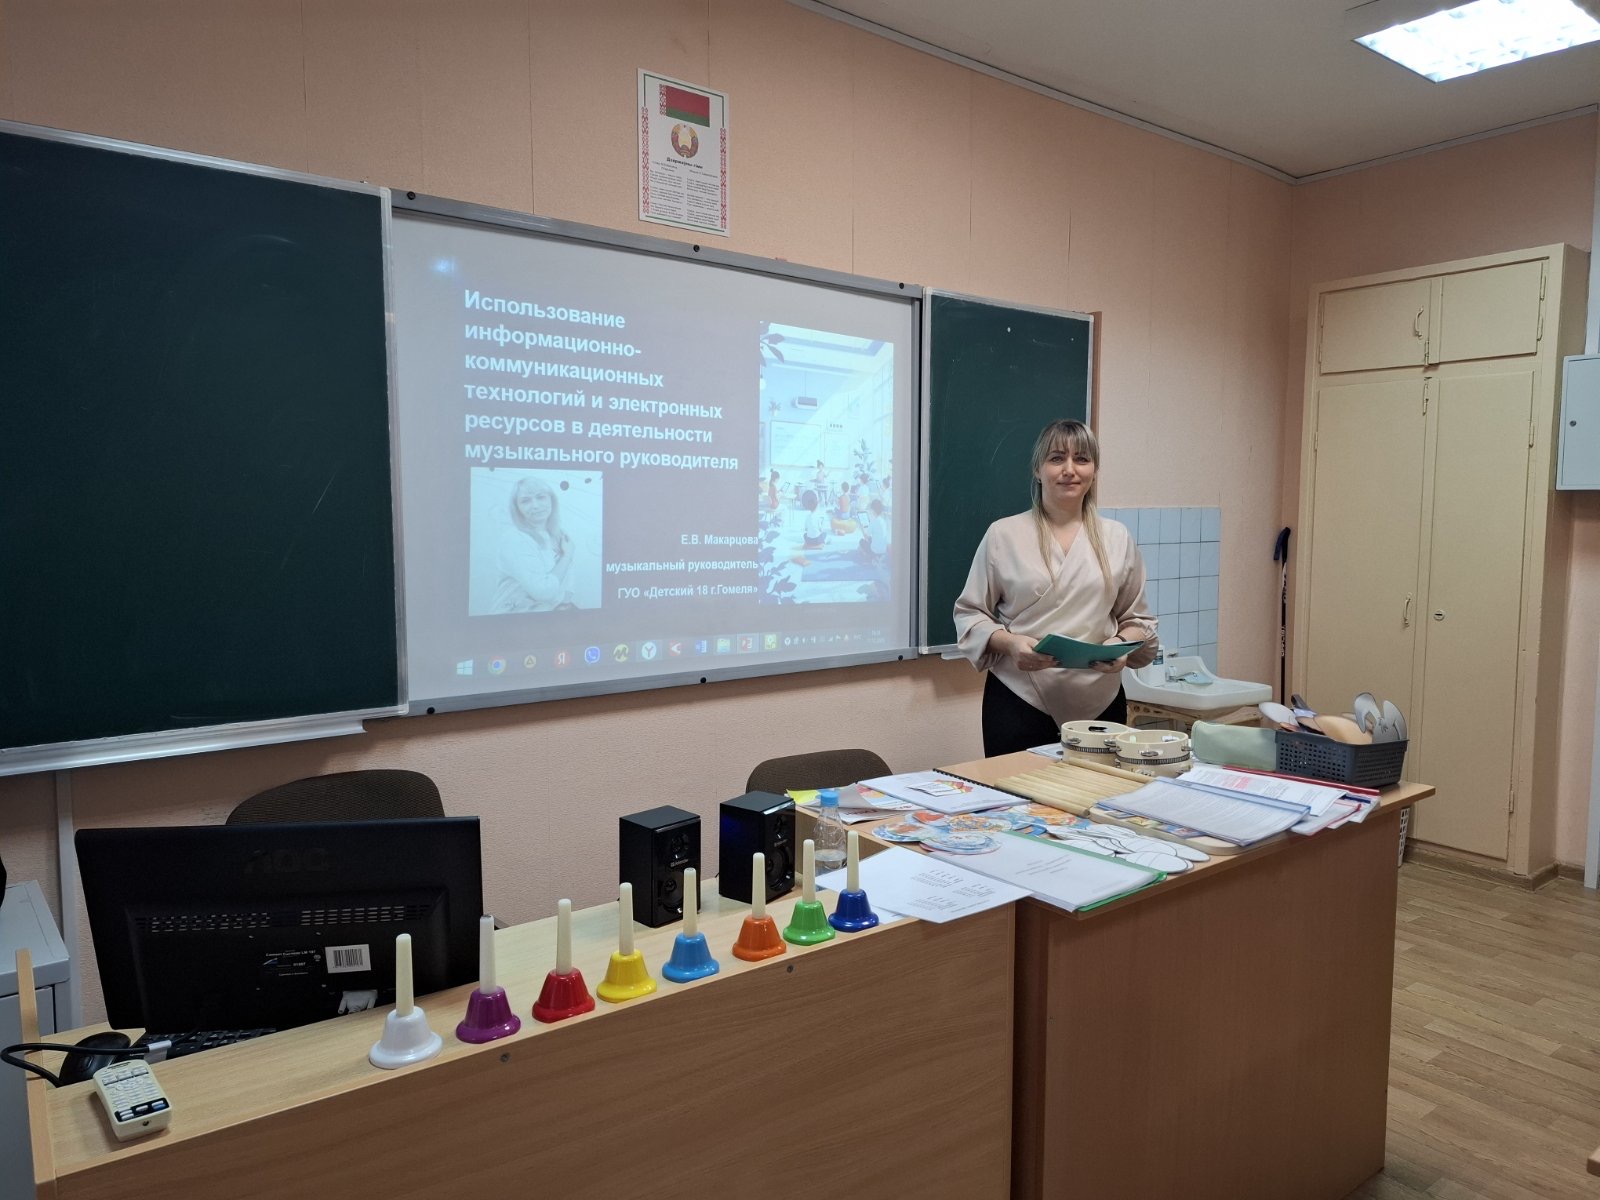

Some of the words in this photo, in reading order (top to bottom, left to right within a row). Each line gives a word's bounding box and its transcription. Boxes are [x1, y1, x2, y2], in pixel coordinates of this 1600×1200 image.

[464, 289, 626, 328] Использование
[464, 324, 642, 357] информационно-
[464, 353, 665, 388] коммуникационных
[464, 384, 585, 408] технологий
[591, 394, 603, 409] и
[608, 395, 723, 419] электронных
[464, 412, 565, 434] ресурсов
[571, 420, 584, 434] в
[588, 421, 713, 443] деятельности
[464, 443, 615, 463] музыкального
[620, 453, 739, 470] руководителя
[681, 534, 702, 545] Е.В.
[704, 534, 759, 547] Макарцова
[606, 559, 685, 574] музыкальный
[688, 560, 759, 572] руководитель
[617, 587, 640, 599] ГУО
[643, 585, 694, 600] «Детский
[697, 585, 708, 596] 18
